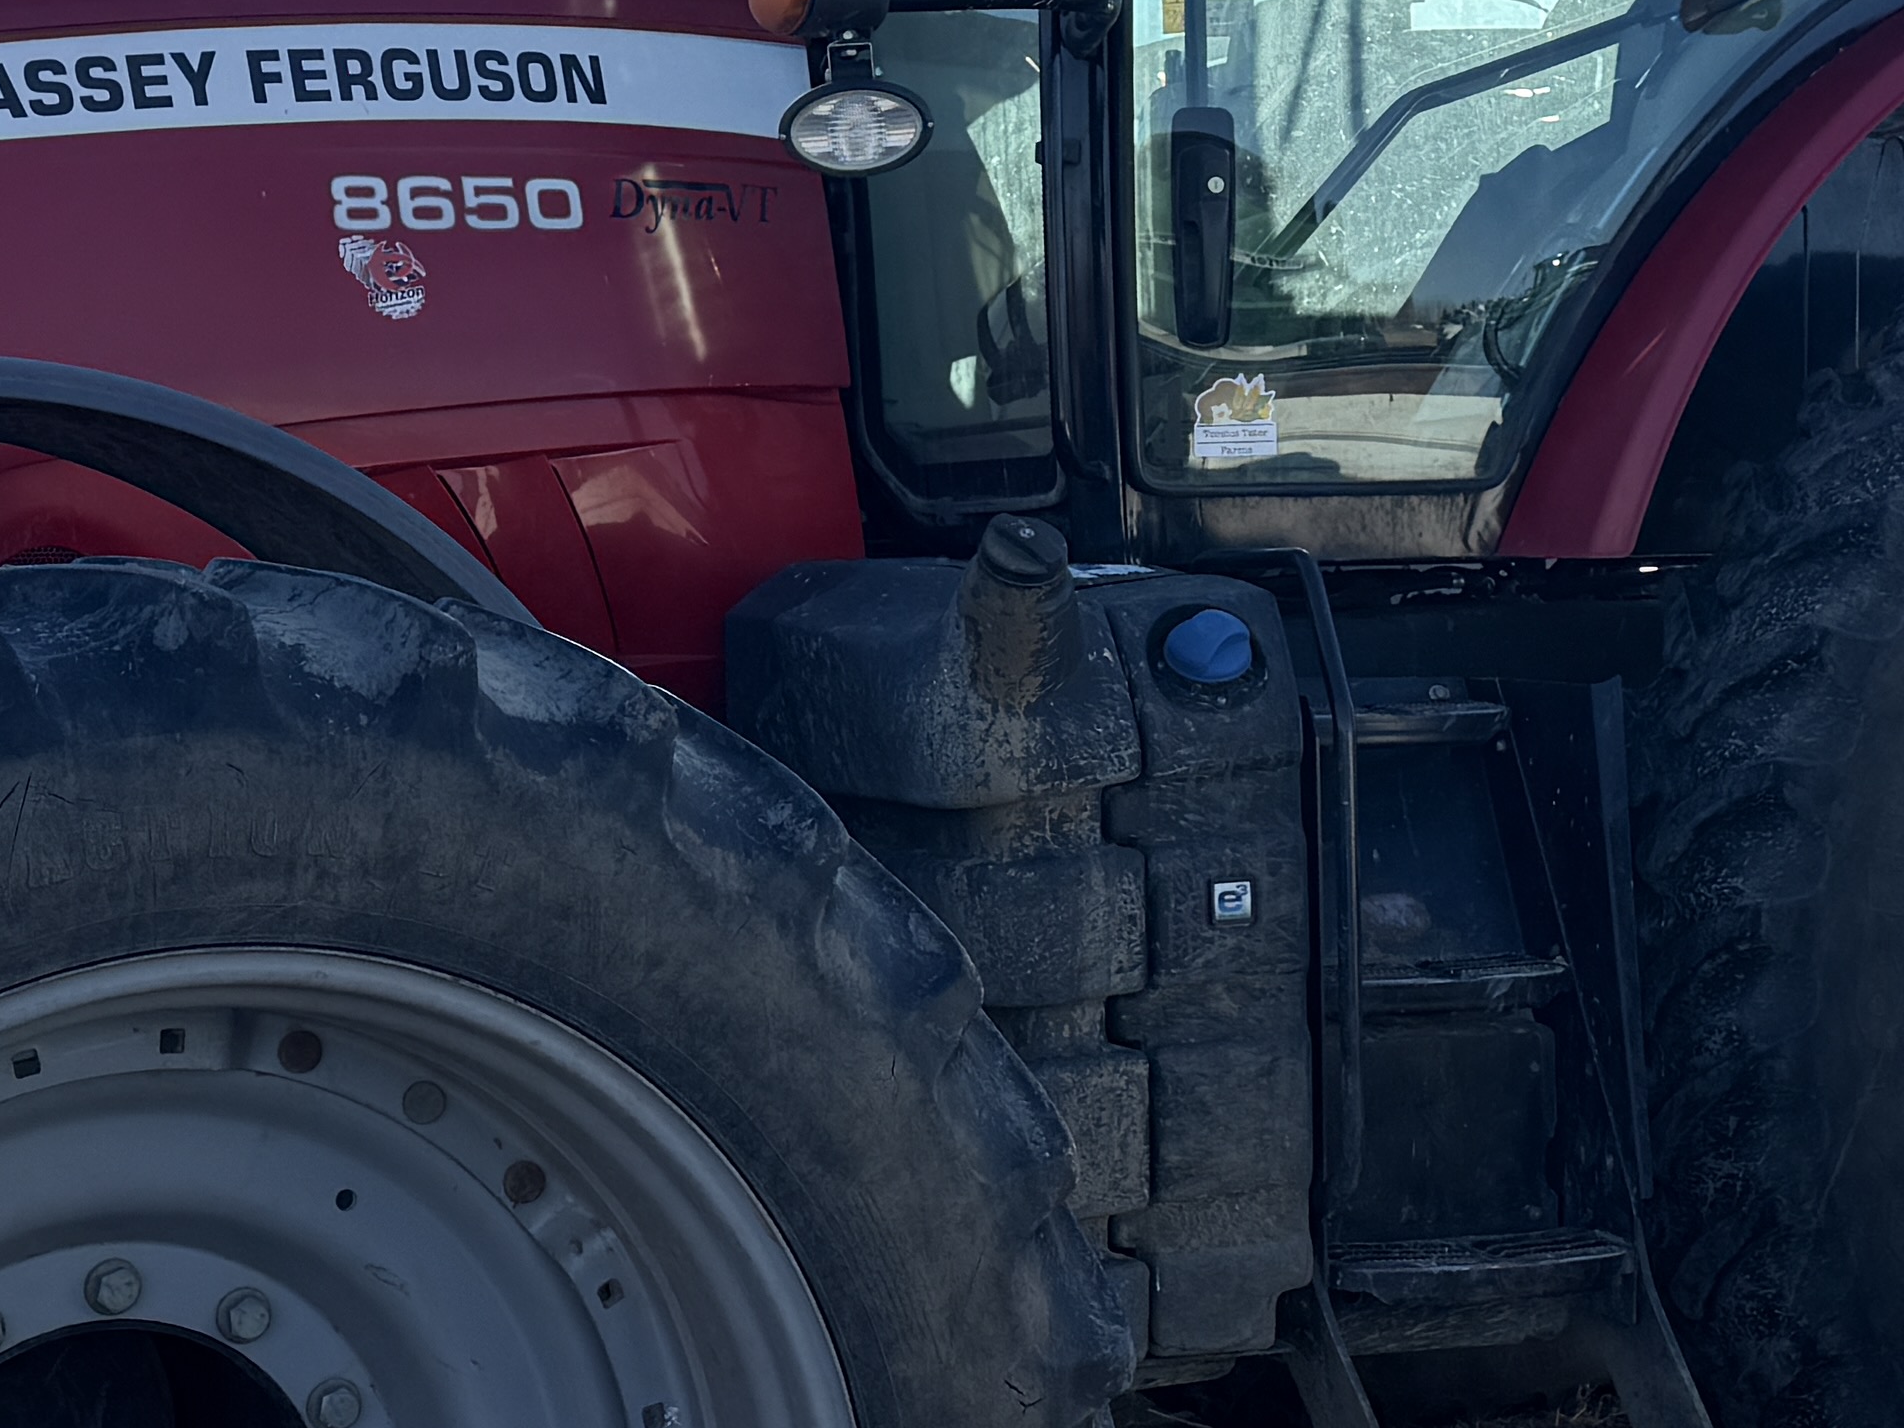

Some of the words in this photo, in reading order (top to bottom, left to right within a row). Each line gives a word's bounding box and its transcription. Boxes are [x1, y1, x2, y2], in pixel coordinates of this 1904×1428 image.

[246, 48, 608, 106] FERGUSON
[330, 175, 584, 231] 8650
[609, 178, 778, 234] Dyna-VT
[368, 287, 425, 305] Horizon
